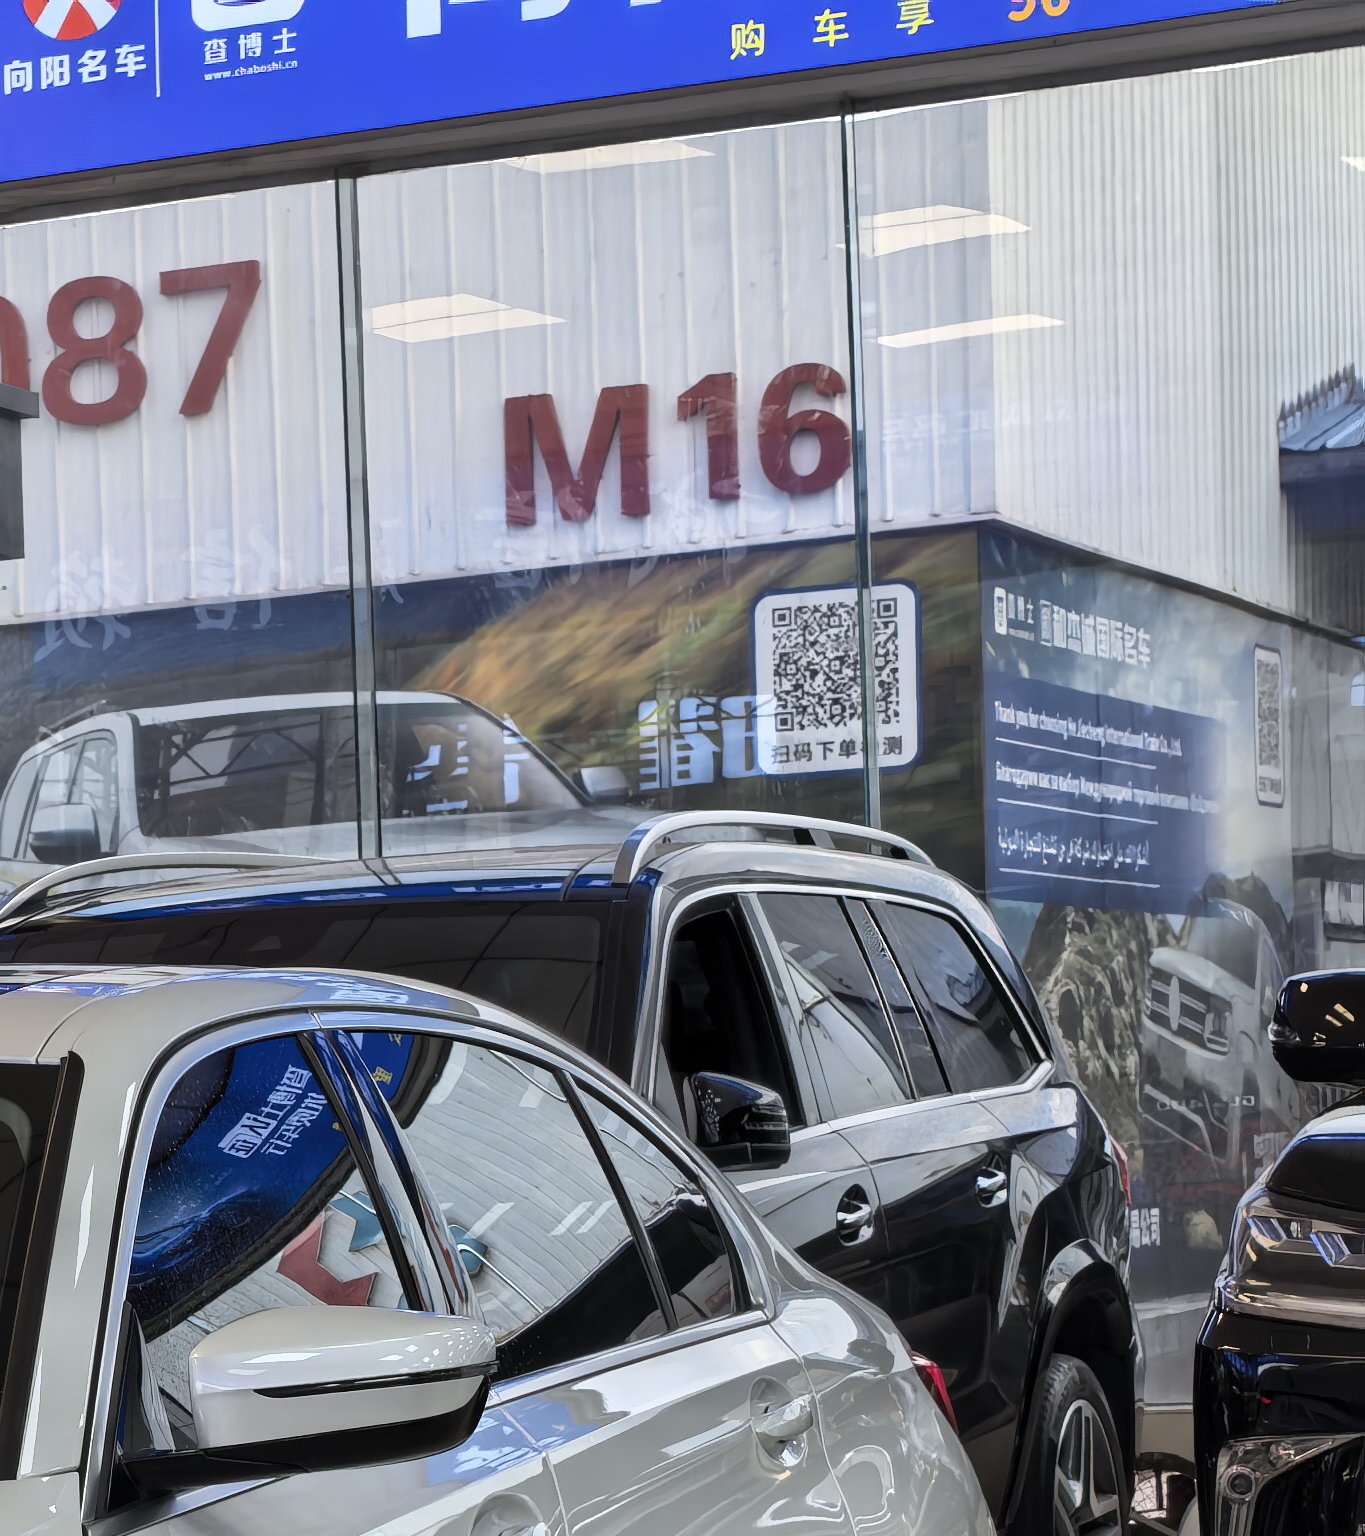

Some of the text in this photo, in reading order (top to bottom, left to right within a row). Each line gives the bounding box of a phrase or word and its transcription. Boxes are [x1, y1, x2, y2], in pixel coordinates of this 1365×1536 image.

[203, 27, 298, 65] 查博士
[3, 44, 148, 95] 向阳名车
[504, 362, 853, 530] M16
[771, 735, 903, 764] 扫码下单测
